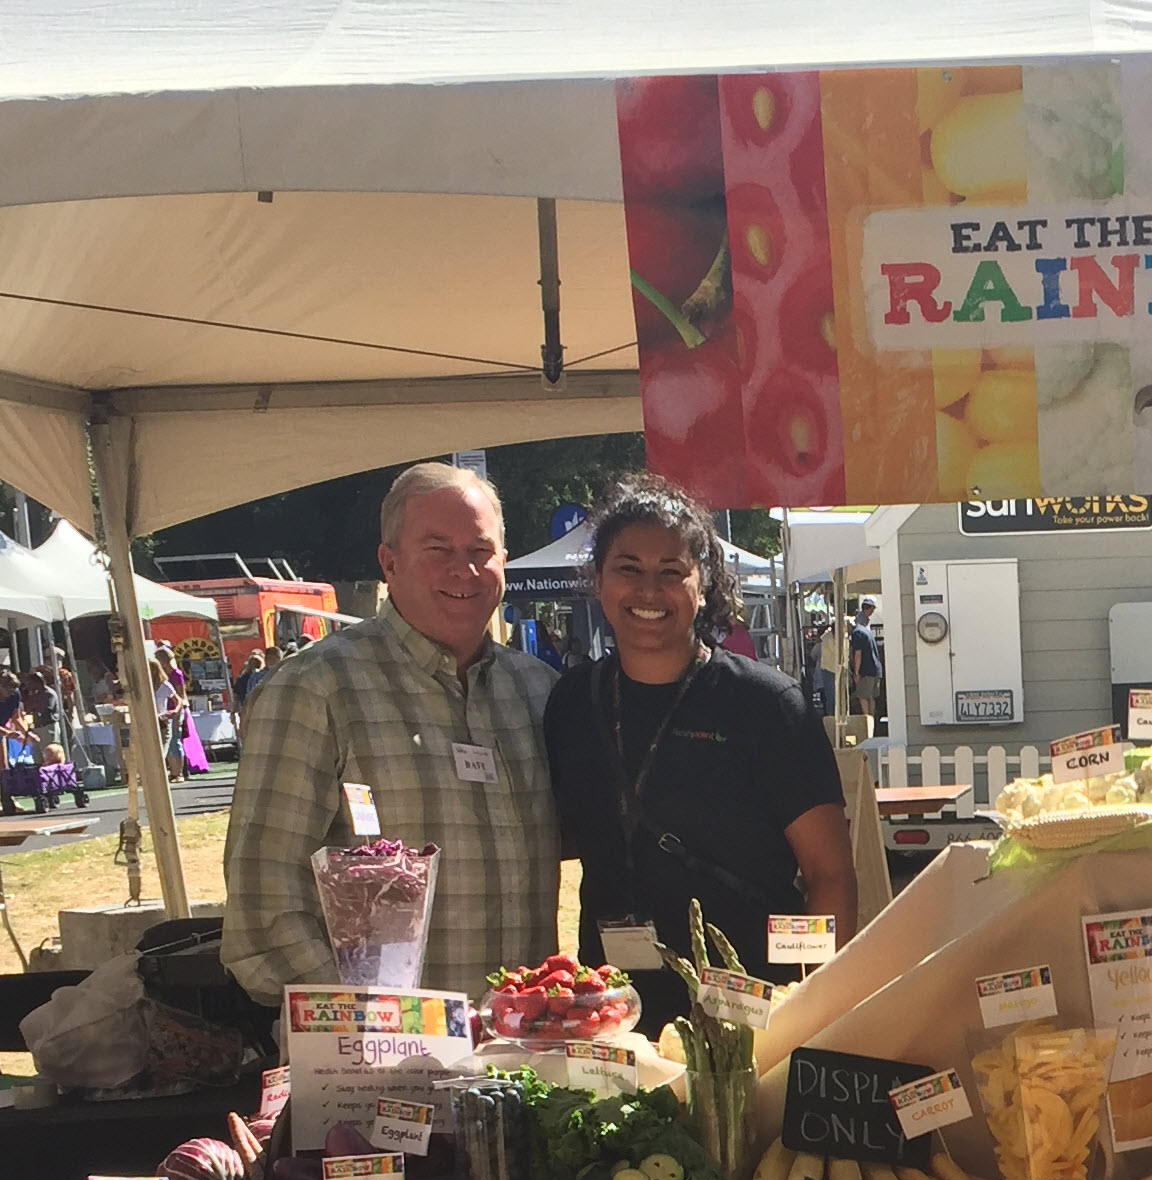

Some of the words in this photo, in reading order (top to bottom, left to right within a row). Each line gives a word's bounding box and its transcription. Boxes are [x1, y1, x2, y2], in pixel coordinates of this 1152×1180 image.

[951, 219, 1047, 253] EAT
[1053, 515, 1073, 525] Take
[1075, 515, 1094, 526] your
[1096, 514, 1123, 526] power
[1066, 751, 1110, 770] CORN
[1110, 930, 1126, 938] EAT
[775, 941, 827, 951] Cauliflower
[704, 994, 764, 1016] Asparagus
[304, 1009, 393, 1022] RAINBOW
[338, 1036, 431, 1065] Eggplant
[582, 1066, 624, 1080] Lettuce
[912, 1099, 955, 1121] CARROT
[381, 1126, 422, 1143] Eggplant
[801, 1112, 905, 1160] ONLY
